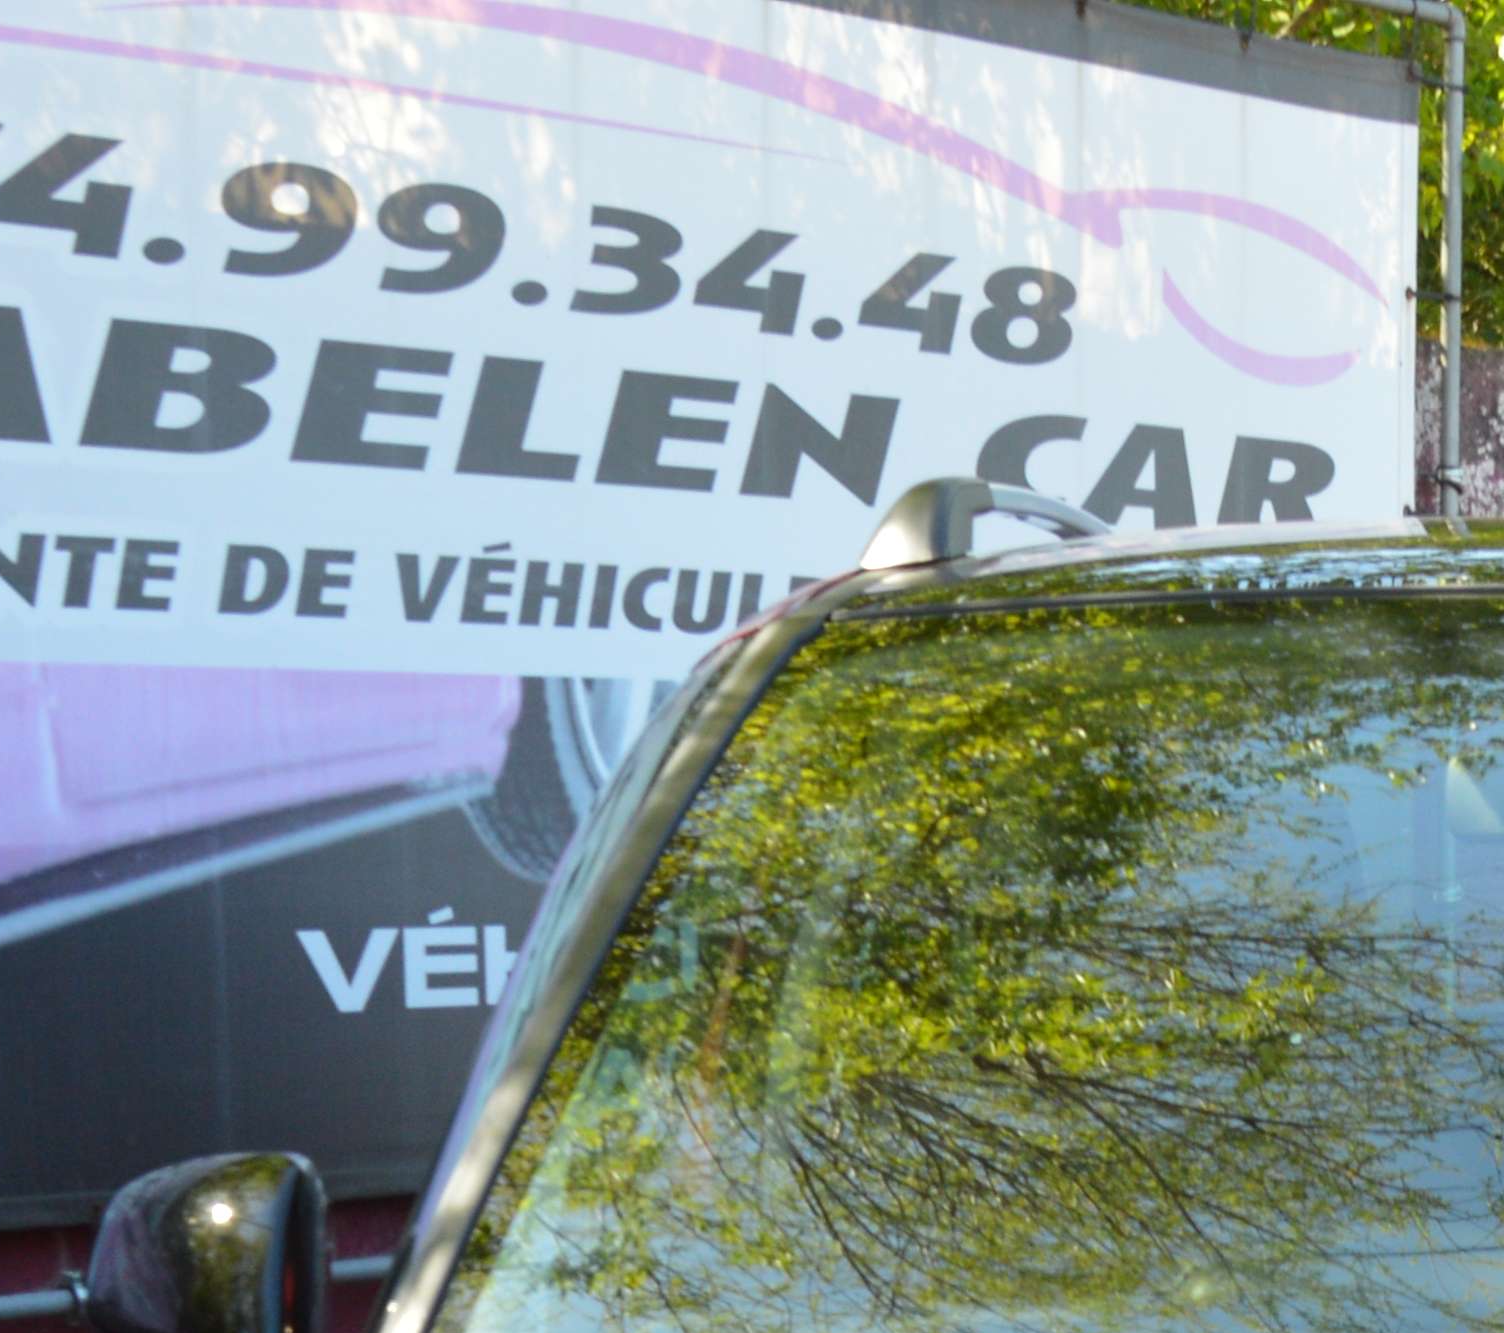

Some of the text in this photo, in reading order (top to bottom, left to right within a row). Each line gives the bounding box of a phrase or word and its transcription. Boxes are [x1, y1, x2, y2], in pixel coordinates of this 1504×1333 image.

[976, 413, 1336, 530] CAR
[216, 543, 356, 618] DE
[395, 541, 823, 635] VÉHICUL
